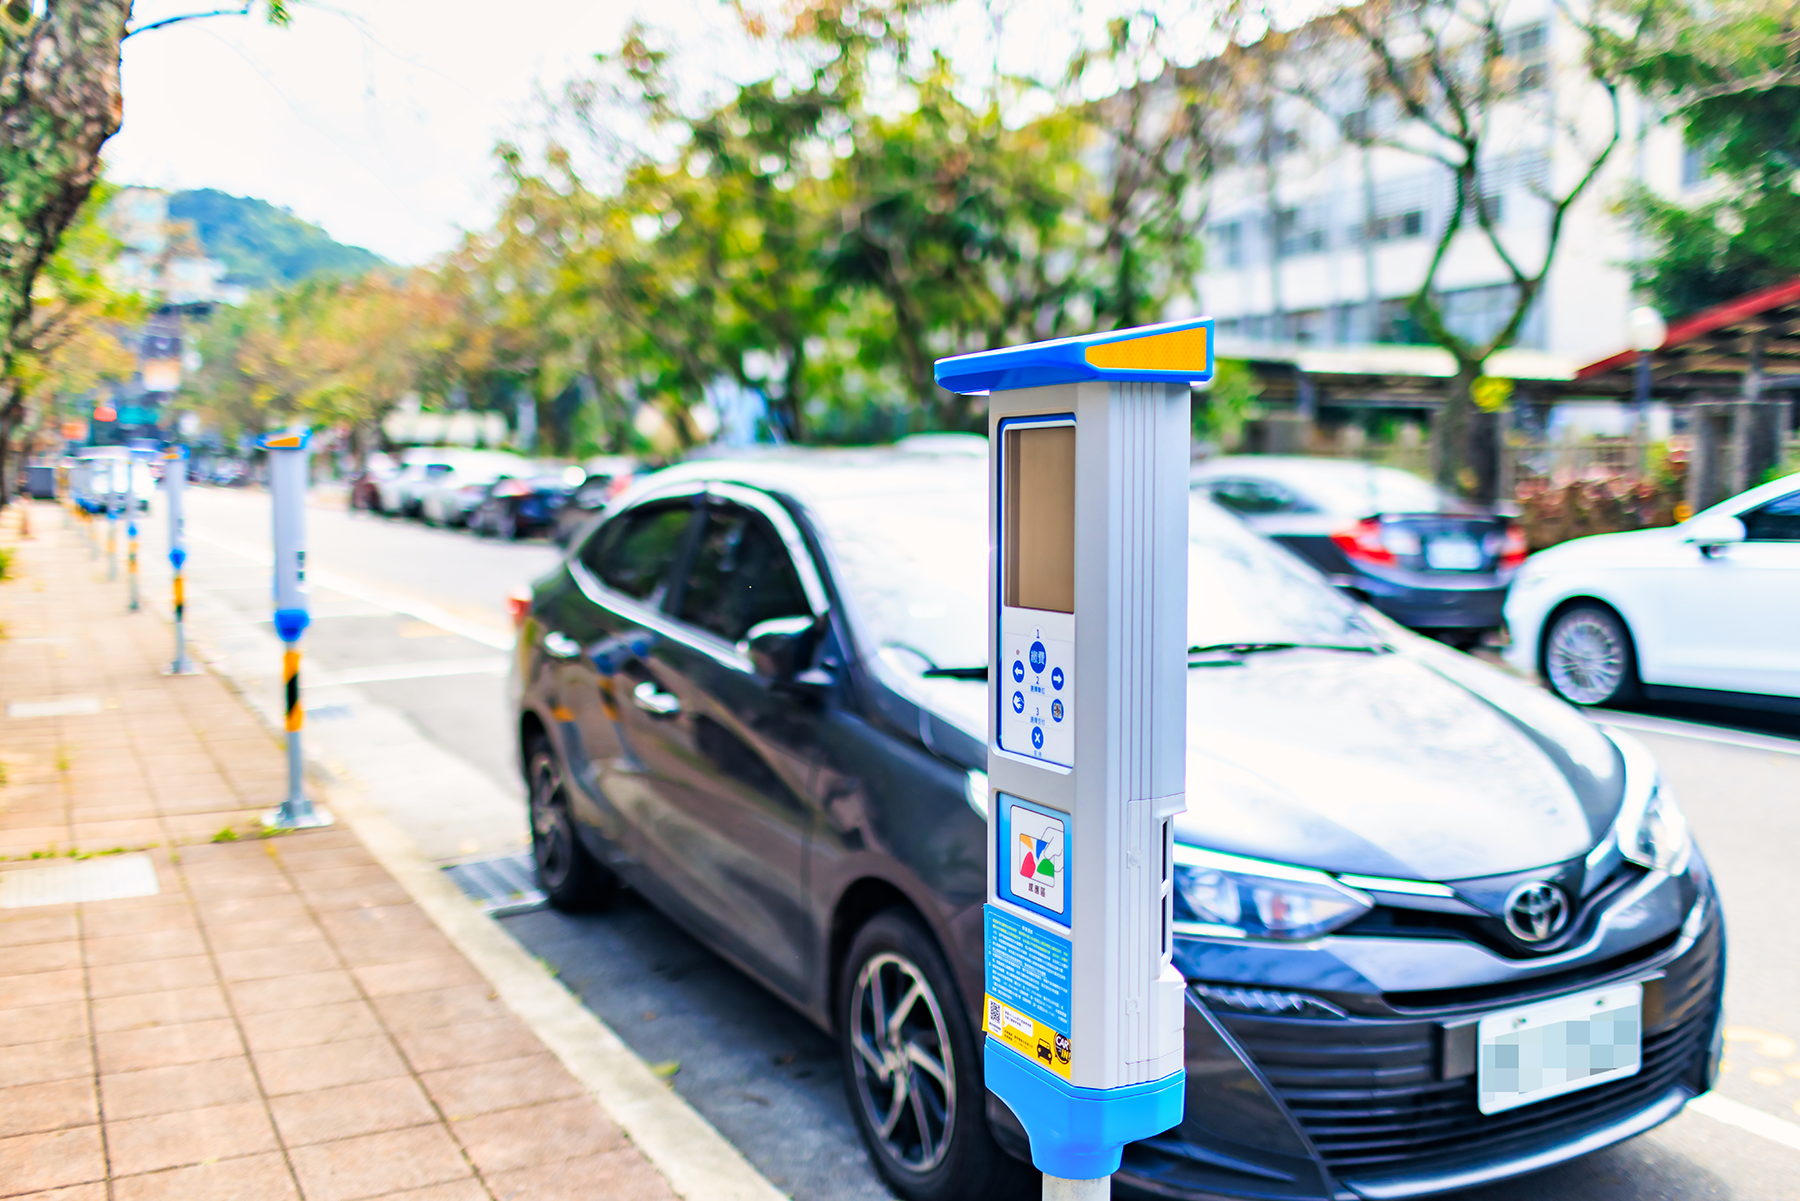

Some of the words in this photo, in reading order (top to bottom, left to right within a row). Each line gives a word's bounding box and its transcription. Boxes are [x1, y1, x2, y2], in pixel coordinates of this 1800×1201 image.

[1036, 629, 1040, 639] 1
[1036, 676, 1040, 685] 2
[1036, 708, 1040, 716] 3
[1028, 882, 1046, 898] 感應區
[1055, 1035, 1069, 1051] CAR
